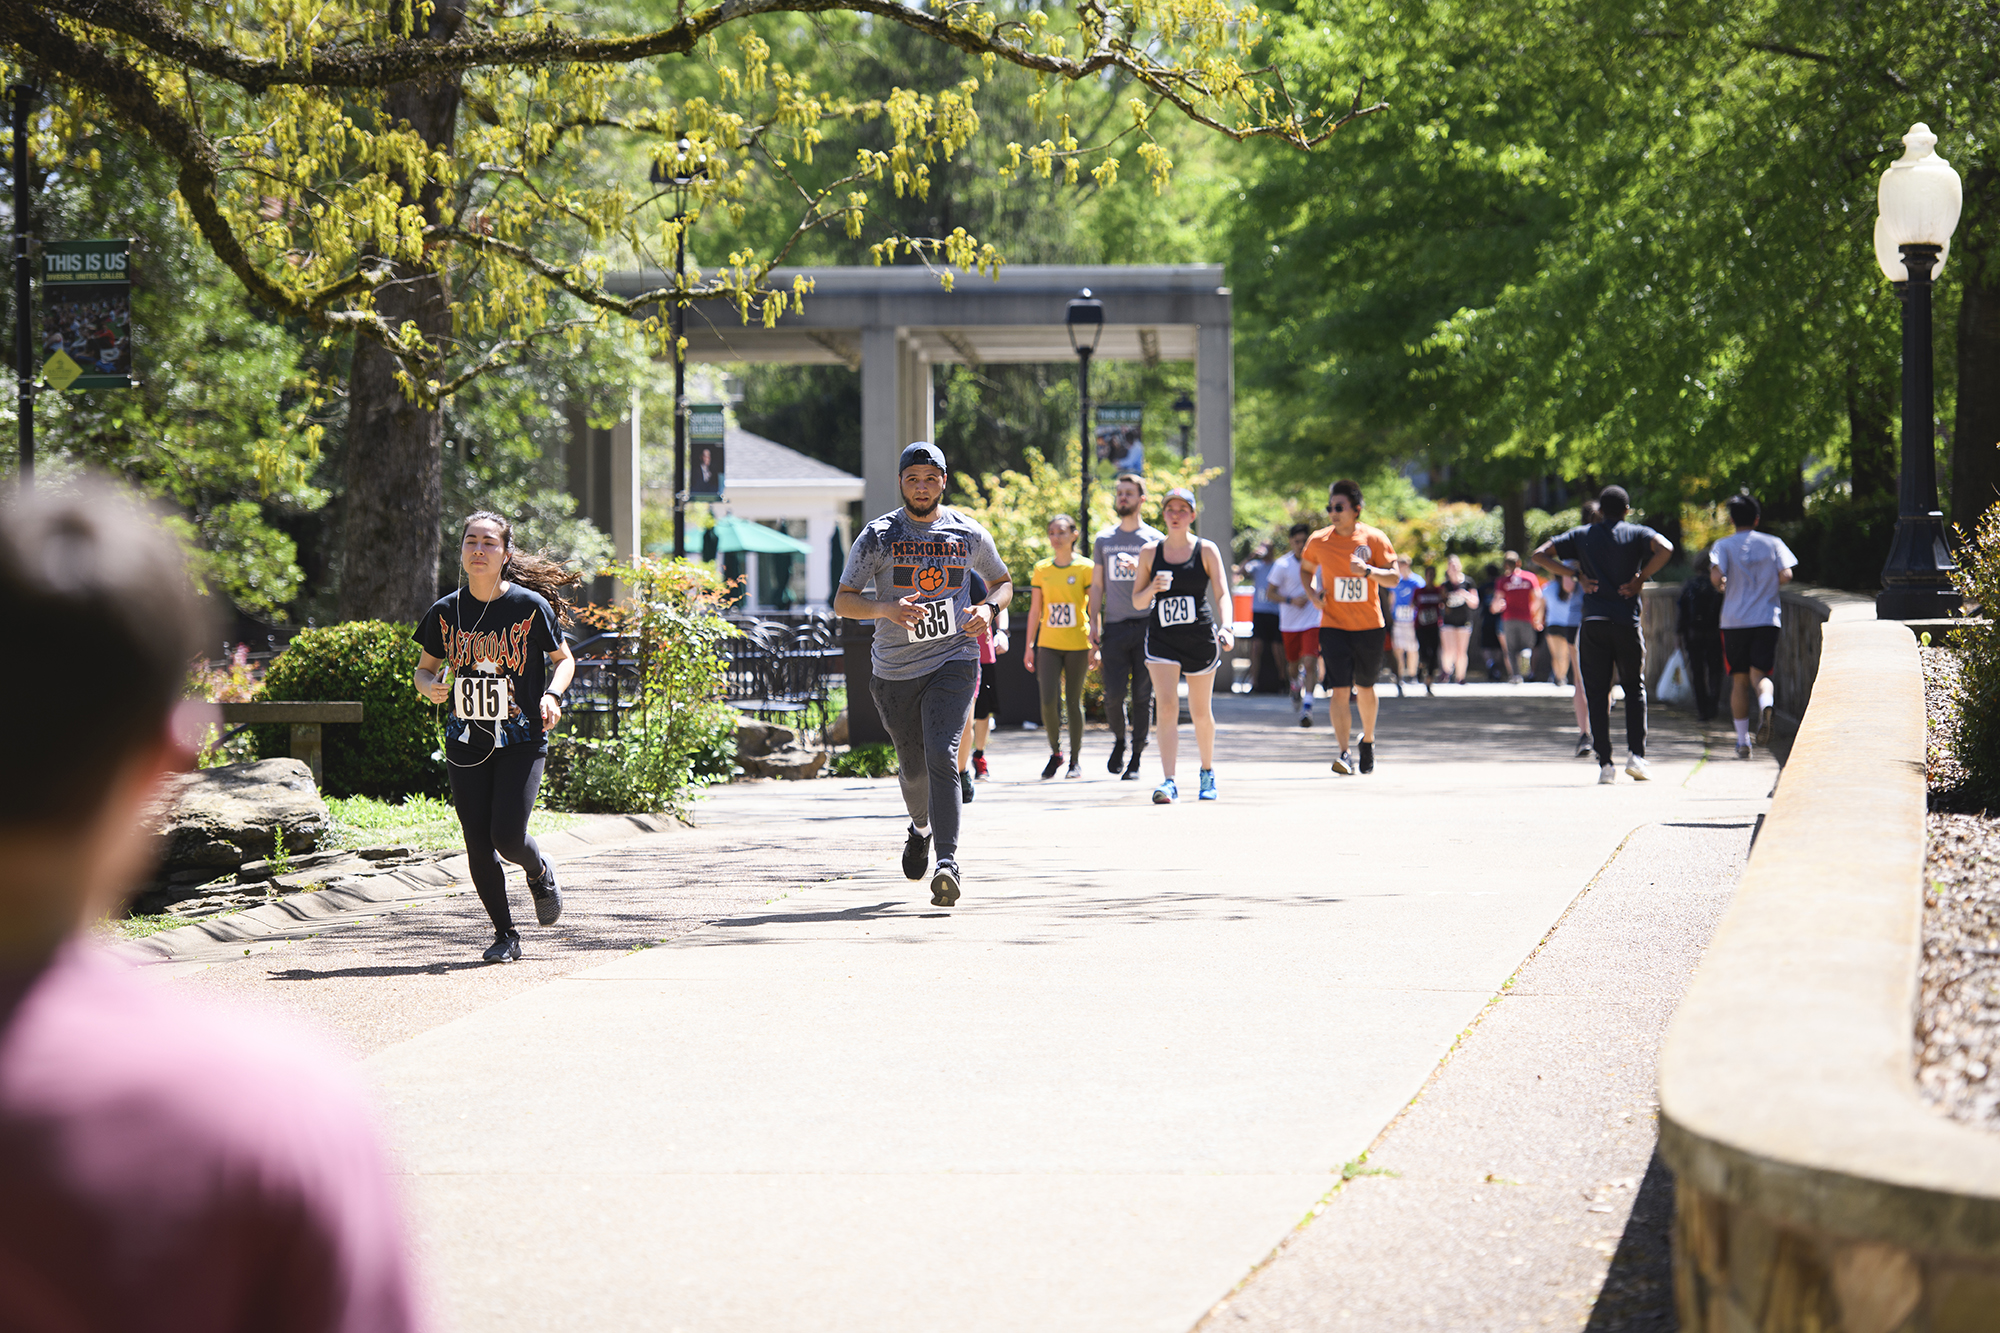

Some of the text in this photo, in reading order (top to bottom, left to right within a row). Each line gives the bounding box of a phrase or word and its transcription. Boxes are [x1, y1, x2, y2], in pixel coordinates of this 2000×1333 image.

[45, 252, 126, 271] THIS IS US
[892, 542, 967, 558] MEMORIAL
[1340, 579, 1362, 599] 799
[1163, 598, 1188, 623] 629
[461, 678, 499, 718] 815
